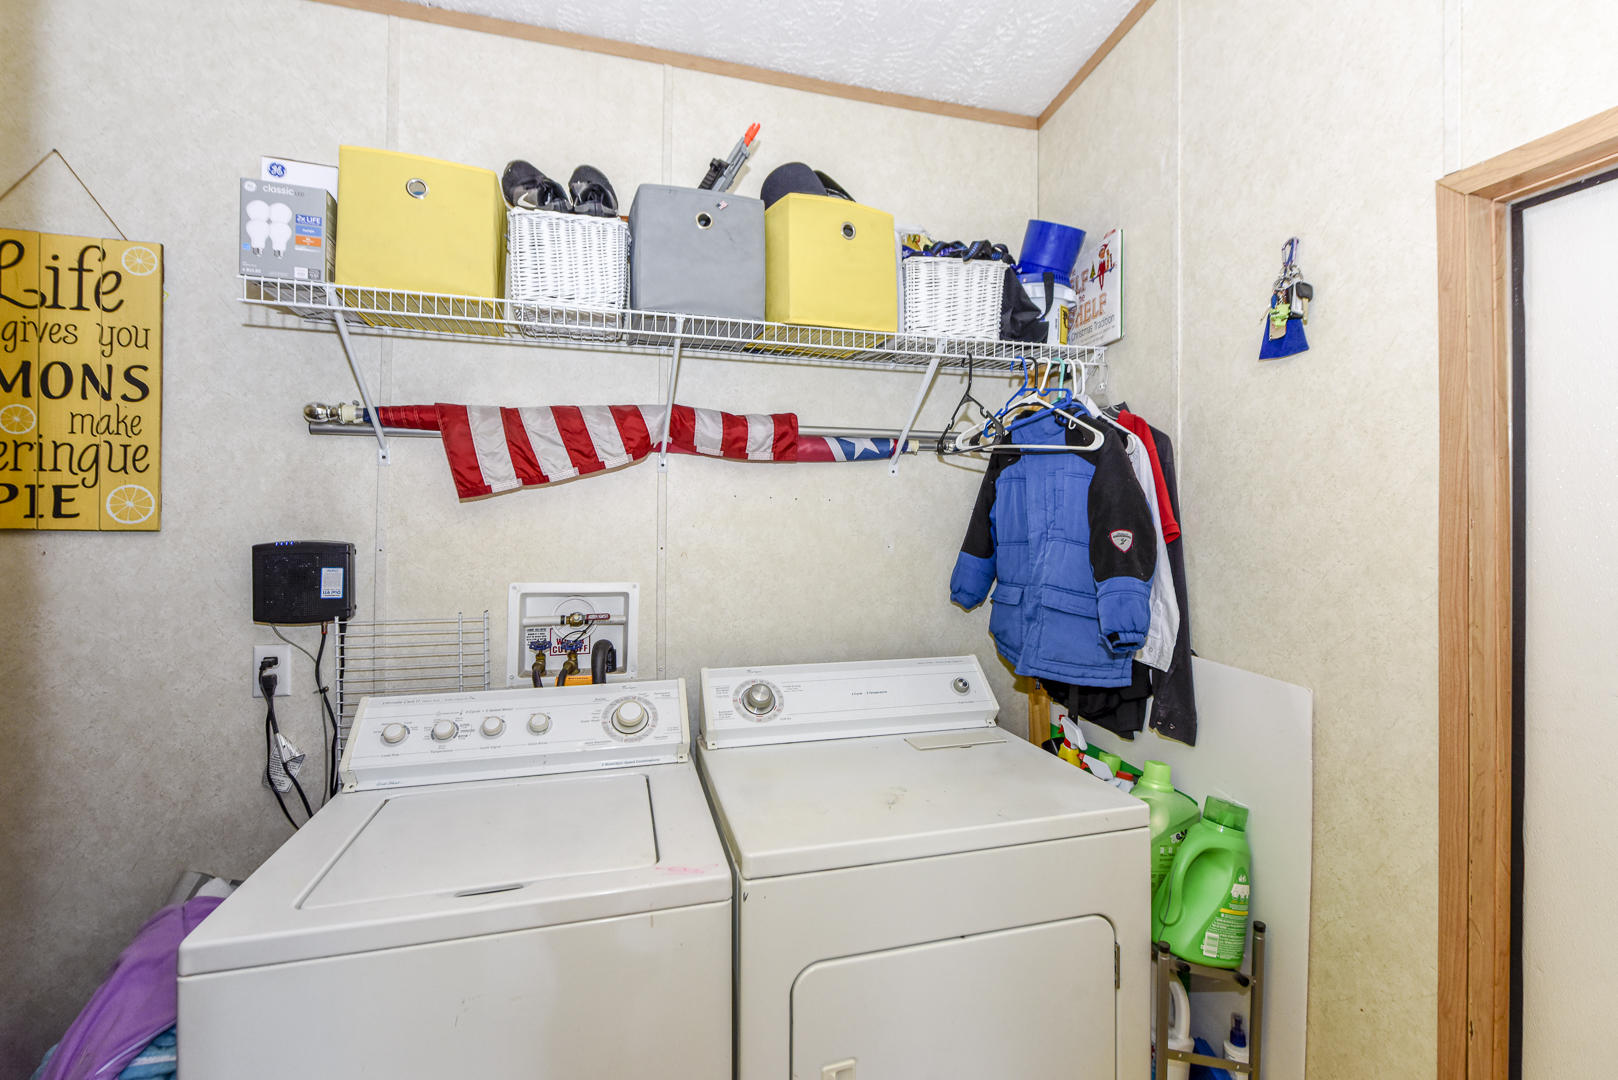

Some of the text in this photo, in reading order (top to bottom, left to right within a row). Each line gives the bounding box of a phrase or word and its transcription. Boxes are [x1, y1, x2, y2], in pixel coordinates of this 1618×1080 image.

[262, 184, 295, 196] classic
[306, 216, 321, 225] LIFE
[0, 239, 124, 313] Life
[1, 315, 150, 358] gives you
[0, 360, 150, 402] MONS
[68, 403, 142, 438] make
